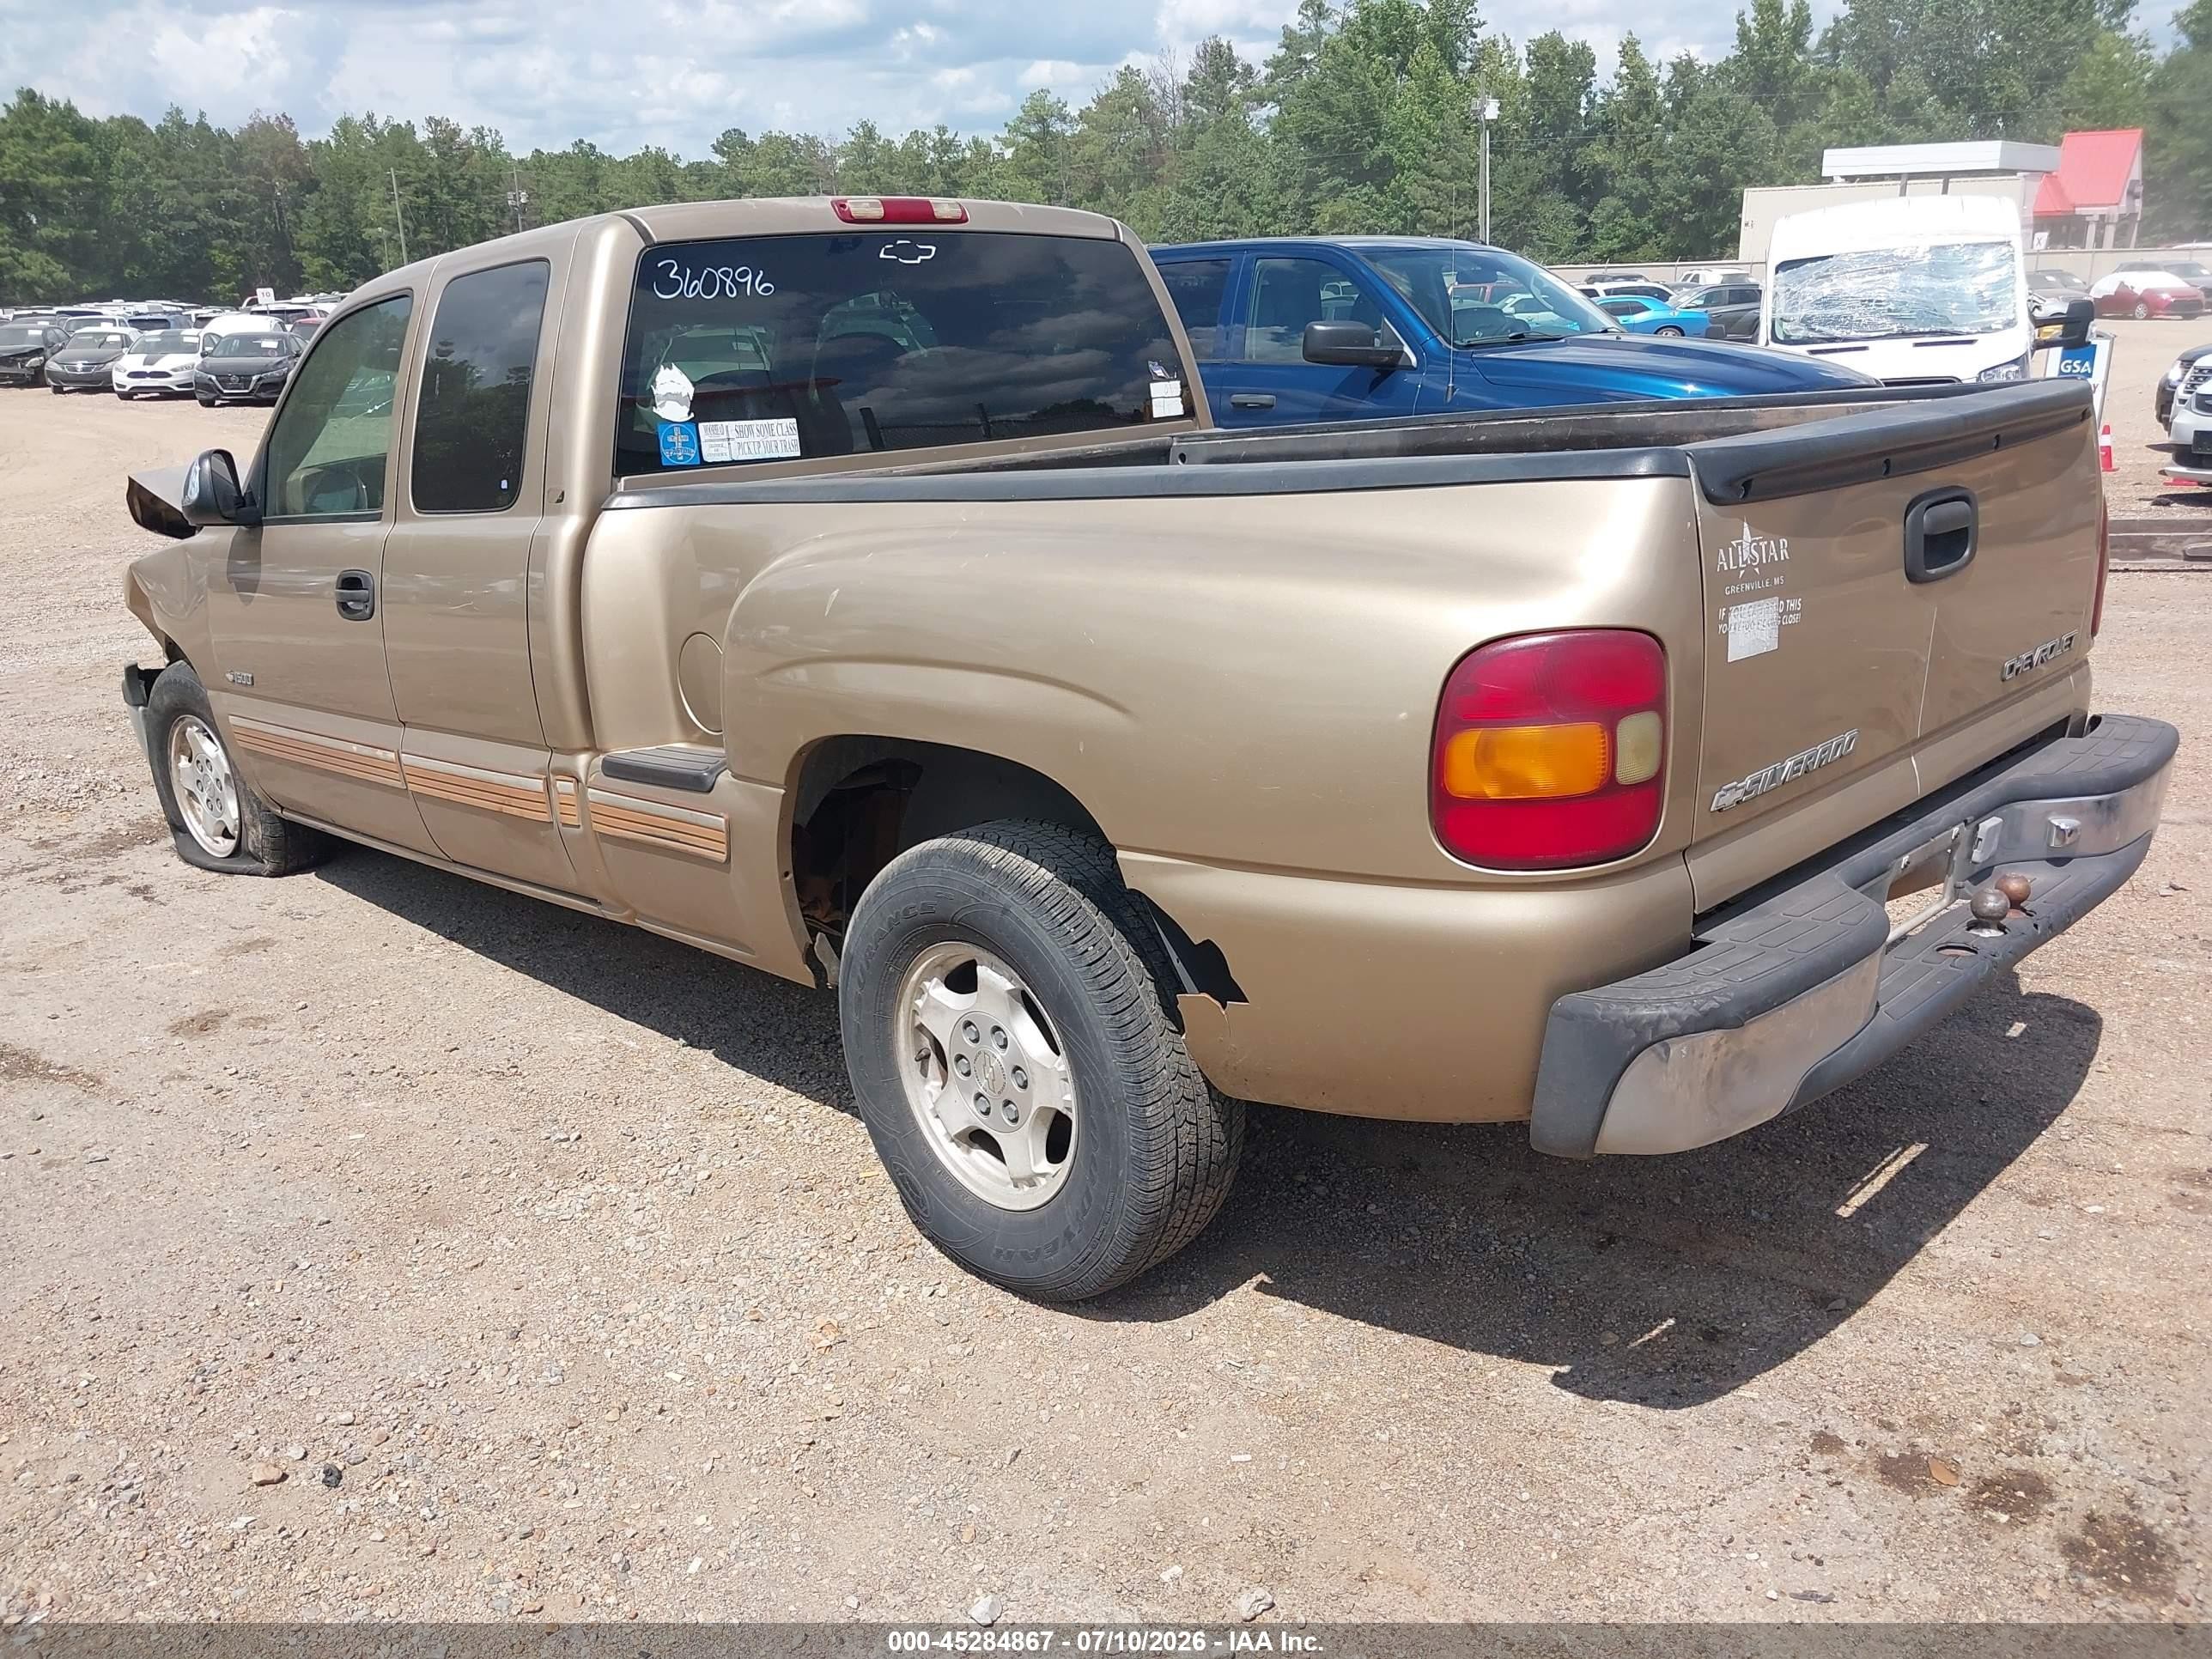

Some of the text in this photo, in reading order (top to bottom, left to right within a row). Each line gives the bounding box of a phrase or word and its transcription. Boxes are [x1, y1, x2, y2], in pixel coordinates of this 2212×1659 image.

[653, 259, 775, 299] 360896
[2060, 359, 2092, 374] GSA
[734, 422, 797, 439] SHOW SOME CLASS
[738, 441, 752, 456] PICK
[752, 441, 761, 455] UP
[762, 440, 779, 454] YOUR
[780, 439, 799, 453] TRASH
[1773, 575, 1785, 586] MS
[1718, 607, 1727, 621] IF
[1786, 599, 1802, 611] THIS
[2002, 629, 2079, 680] CHEVROLET
[234, 672, 253, 686] 1500
[1742, 729, 1859, 802] SILVERADO
